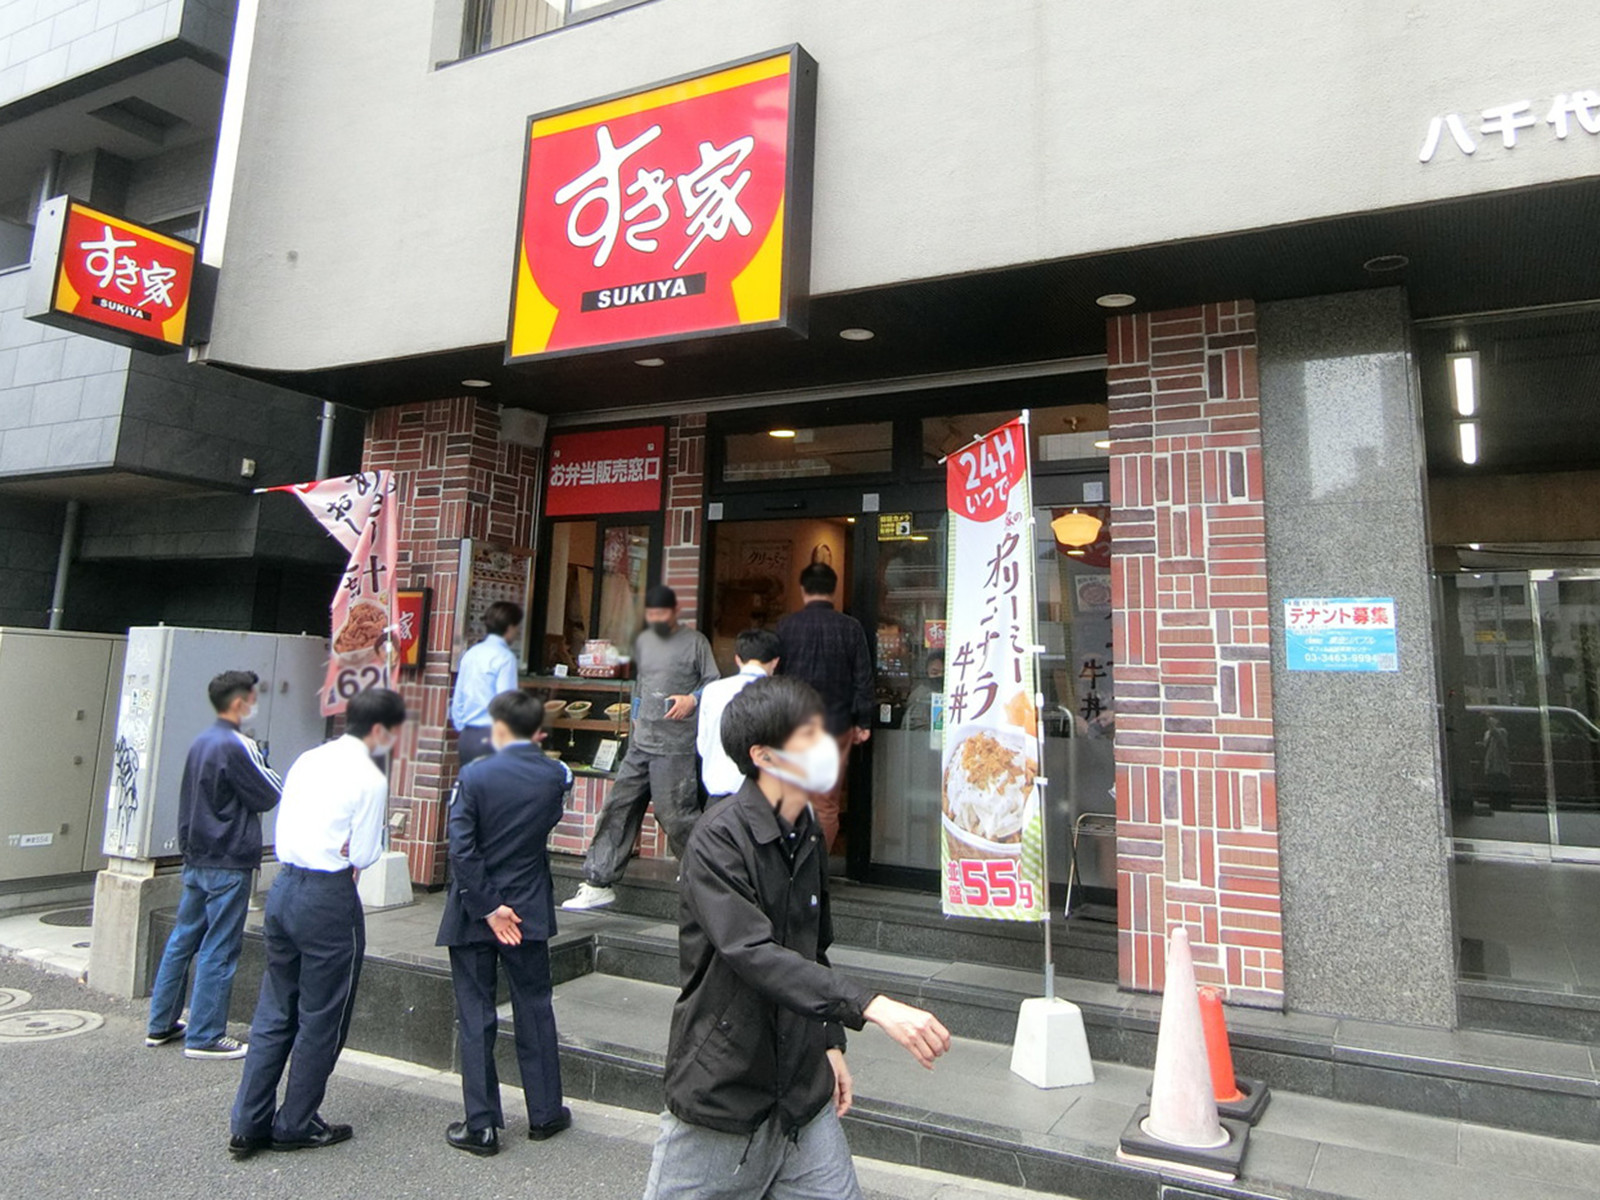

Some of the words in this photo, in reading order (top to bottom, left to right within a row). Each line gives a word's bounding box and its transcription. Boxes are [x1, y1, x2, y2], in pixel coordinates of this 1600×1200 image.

[554, 124, 754, 271] すき家
[80, 225, 177, 307] すき家
[100, 298, 144, 319] SUKIYA
[597, 277, 688, 309] SUKIYA
[550, 457, 660, 487] お弁当販売窓口
[959, 428, 1015, 490] 24H
[1001, 532, 1025, 684] クリーミー
[1290, 607, 1389, 625] テナント募集
